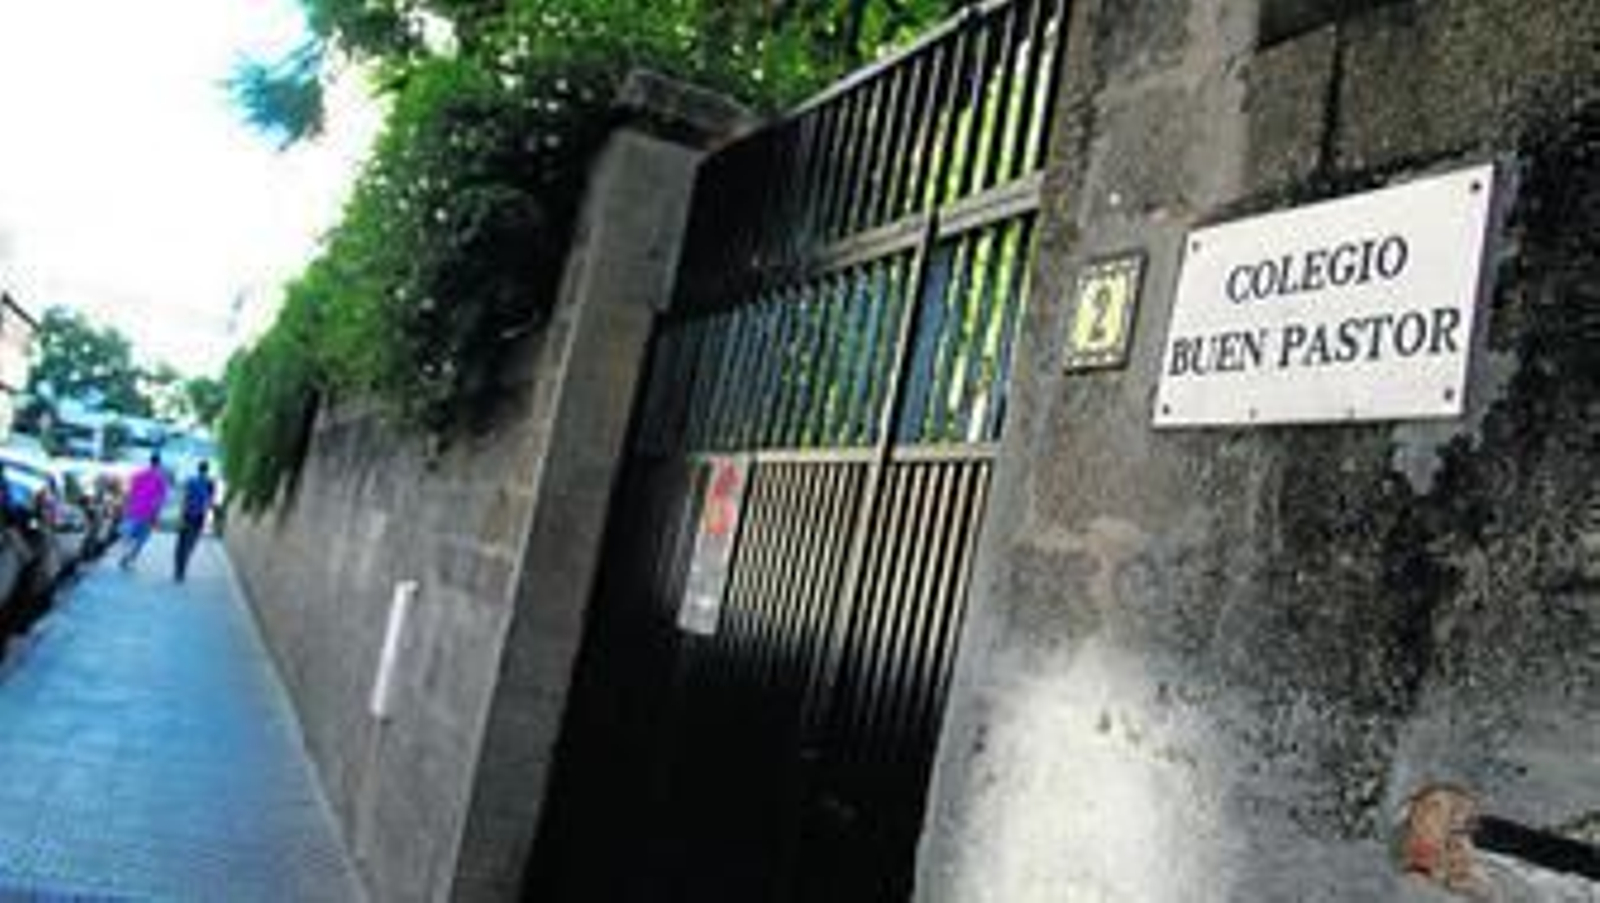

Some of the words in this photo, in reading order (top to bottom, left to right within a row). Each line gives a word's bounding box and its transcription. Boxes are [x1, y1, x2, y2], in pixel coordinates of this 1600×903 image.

[1225, 235, 1409, 304] COLEGIO
[1087, 285, 1112, 342] 2
[1168, 327, 1268, 377] BUEN
[1277, 307, 1462, 369] PASTOR
